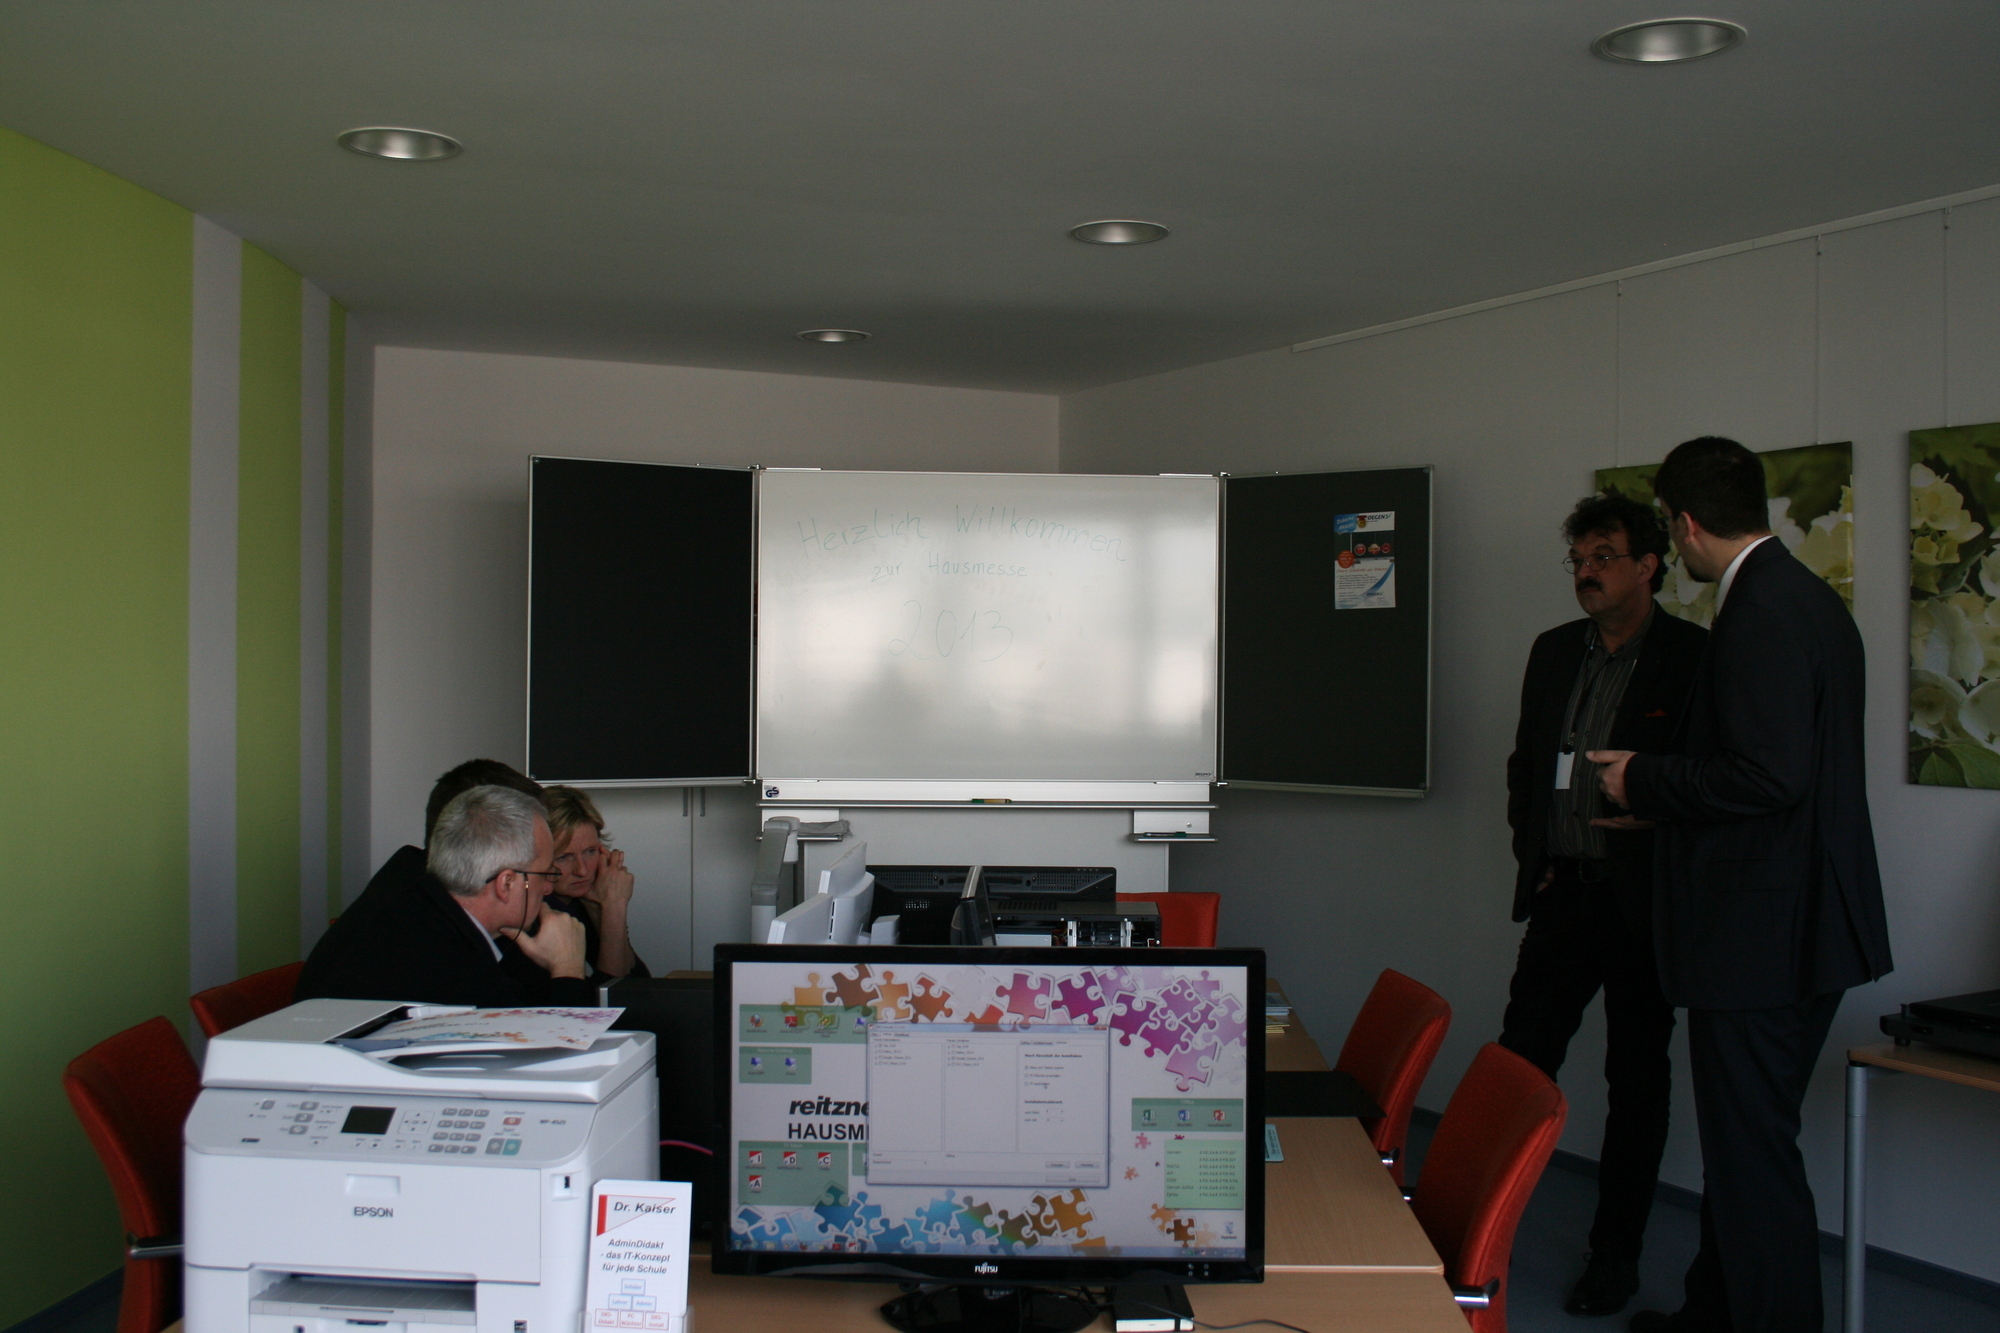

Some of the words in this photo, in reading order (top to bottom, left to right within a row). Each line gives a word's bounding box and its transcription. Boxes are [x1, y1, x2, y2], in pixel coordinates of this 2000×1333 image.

[798, 508, 928, 558] Herzlich
[955, 504, 1127, 562] Willkommen
[871, 561, 903, 582] zur
[928, 551, 1028, 578] Hausmesse
[888, 599, 1014, 662] 2013
[788, 1123, 867, 1140] HAUSM
[353, 1206, 394, 1218] EPSON
[614, 1202, 630, 1212] Dr.
[635, 1203, 677, 1214] Kaiser
[608, 1238, 664, 1249] AdminDidakt
[606, 1250, 622, 1259] das
[623, 1251, 671, 1263] IT-Konzept
[602, 1262, 615, 1271] für
[616, 1263, 635, 1273] jede
[637, 1264, 667, 1274] Schule
[974, 1261, 998, 1275] FUJITSU
